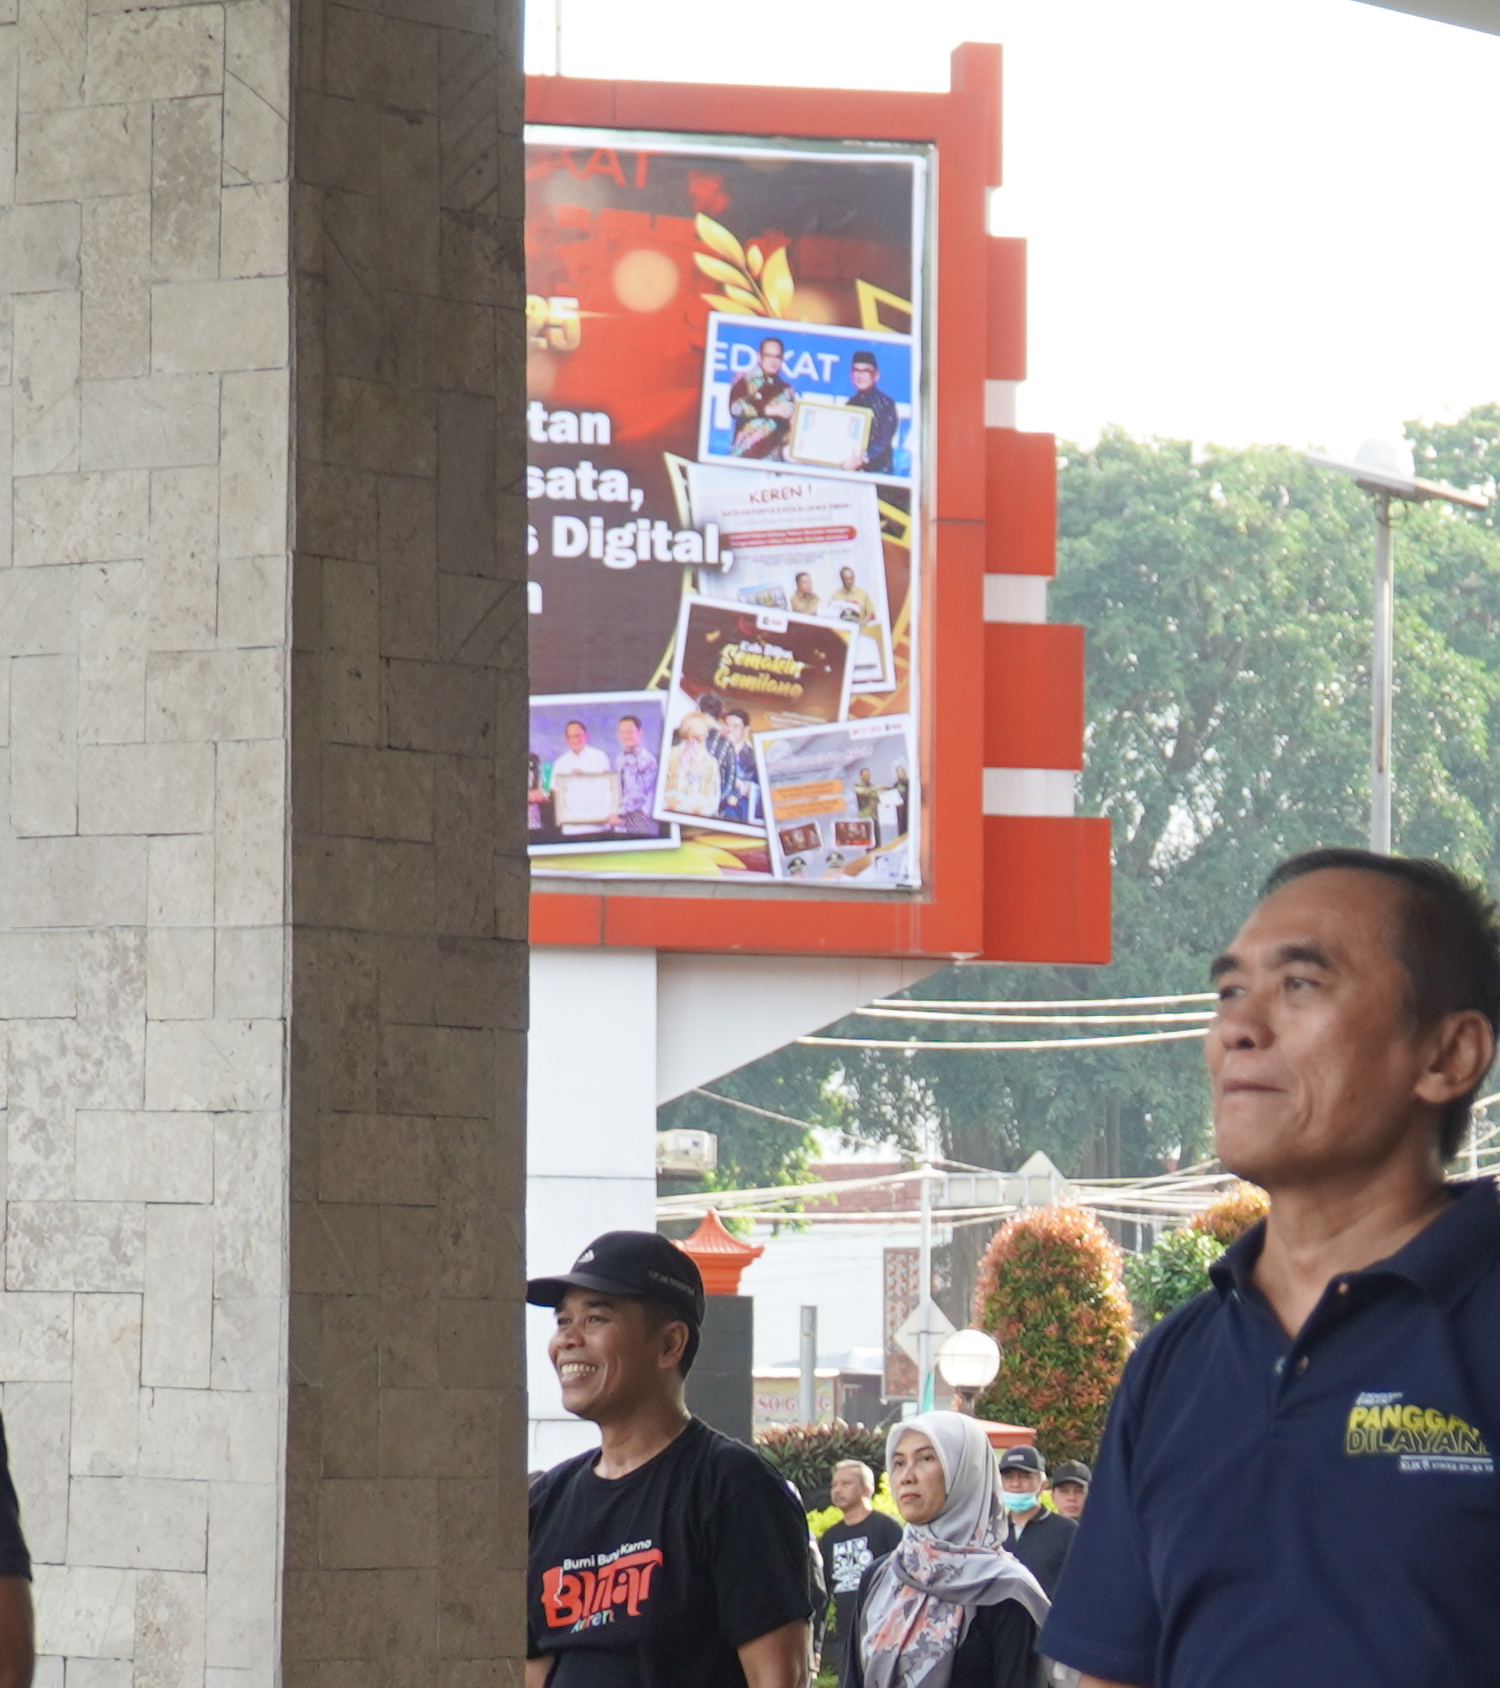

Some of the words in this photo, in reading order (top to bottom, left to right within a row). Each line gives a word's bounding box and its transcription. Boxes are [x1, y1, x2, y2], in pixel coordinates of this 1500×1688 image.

[749, 484, 803, 504] KEREN
[553, 515, 734, 573] Digital,
[563, 1554, 595, 1571] Bumi
[620, 1539, 653, 1555] Karno
